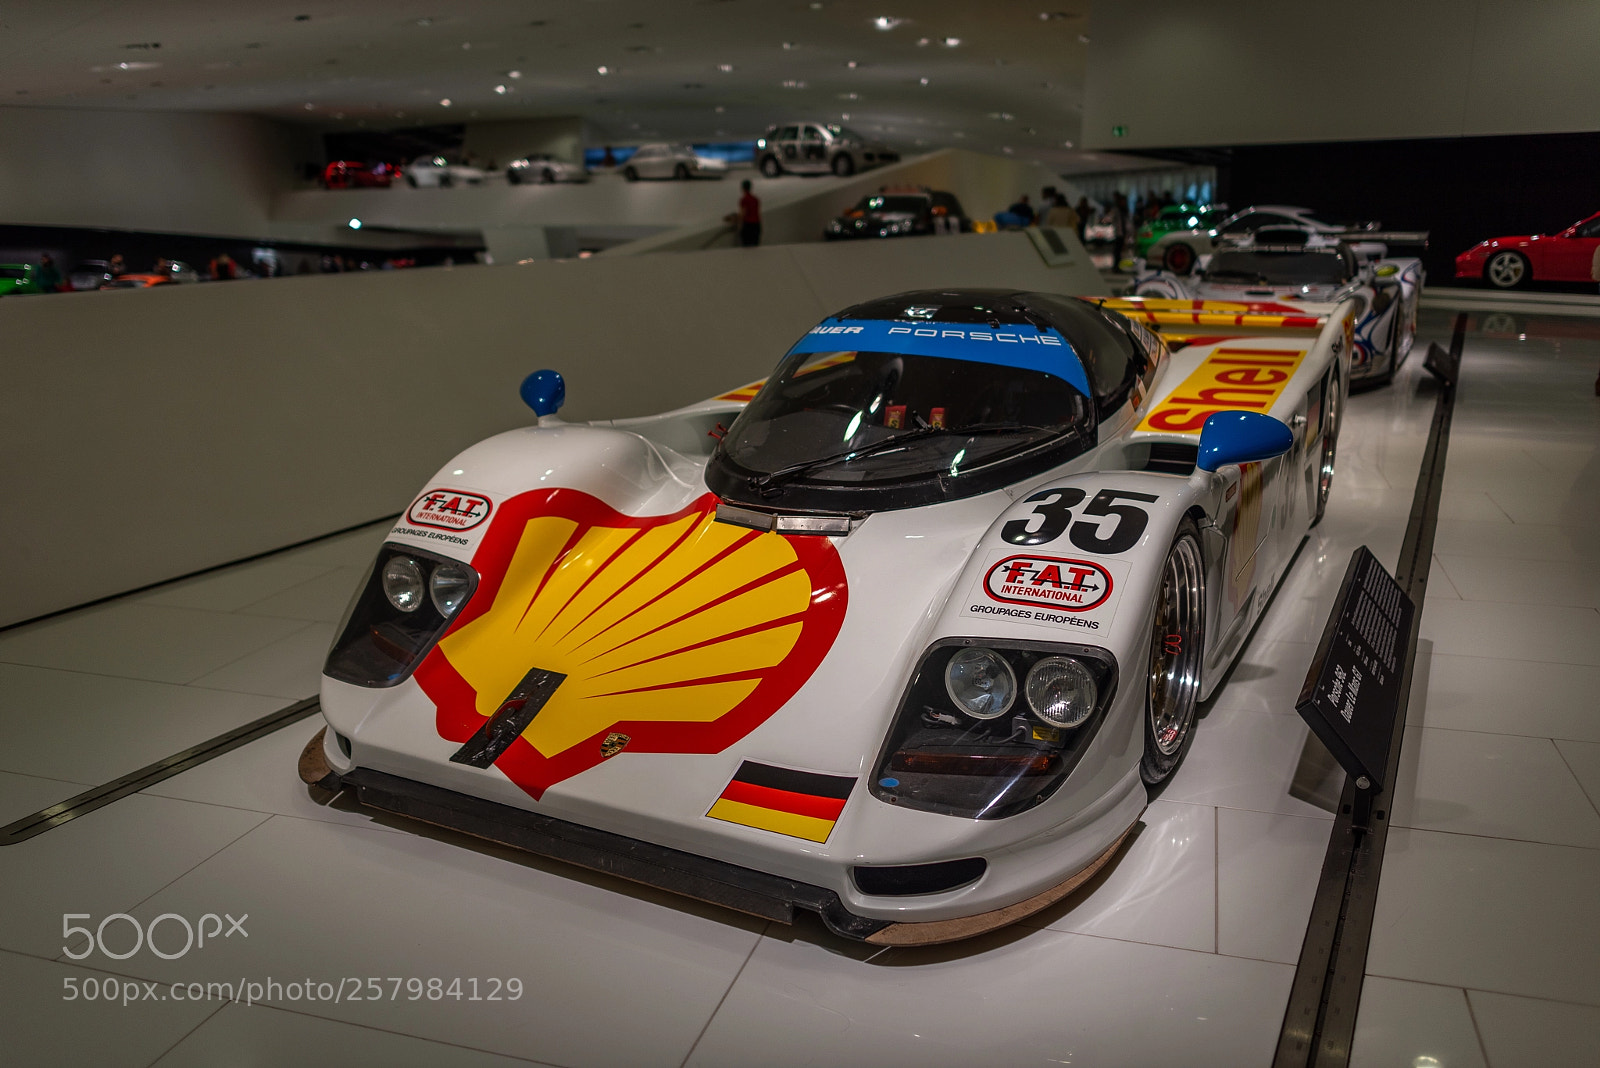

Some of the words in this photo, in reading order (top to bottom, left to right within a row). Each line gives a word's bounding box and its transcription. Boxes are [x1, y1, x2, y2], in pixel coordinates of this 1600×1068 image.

[888, 327, 1062, 346] PORSCHE
[1148, 348, 1301, 431] Shell
[416, 511, 467, 526] INTERNATIONAL
[1000, 487, 1160, 555] 35
[427, 531, 469, 545] EUROPÉENS
[1000, 584, 1084, 604] INTERNATIONAL
[970, 604, 1032, 619] GROUPAGES
[1034, 612, 1100, 630] EUROPÉENS
